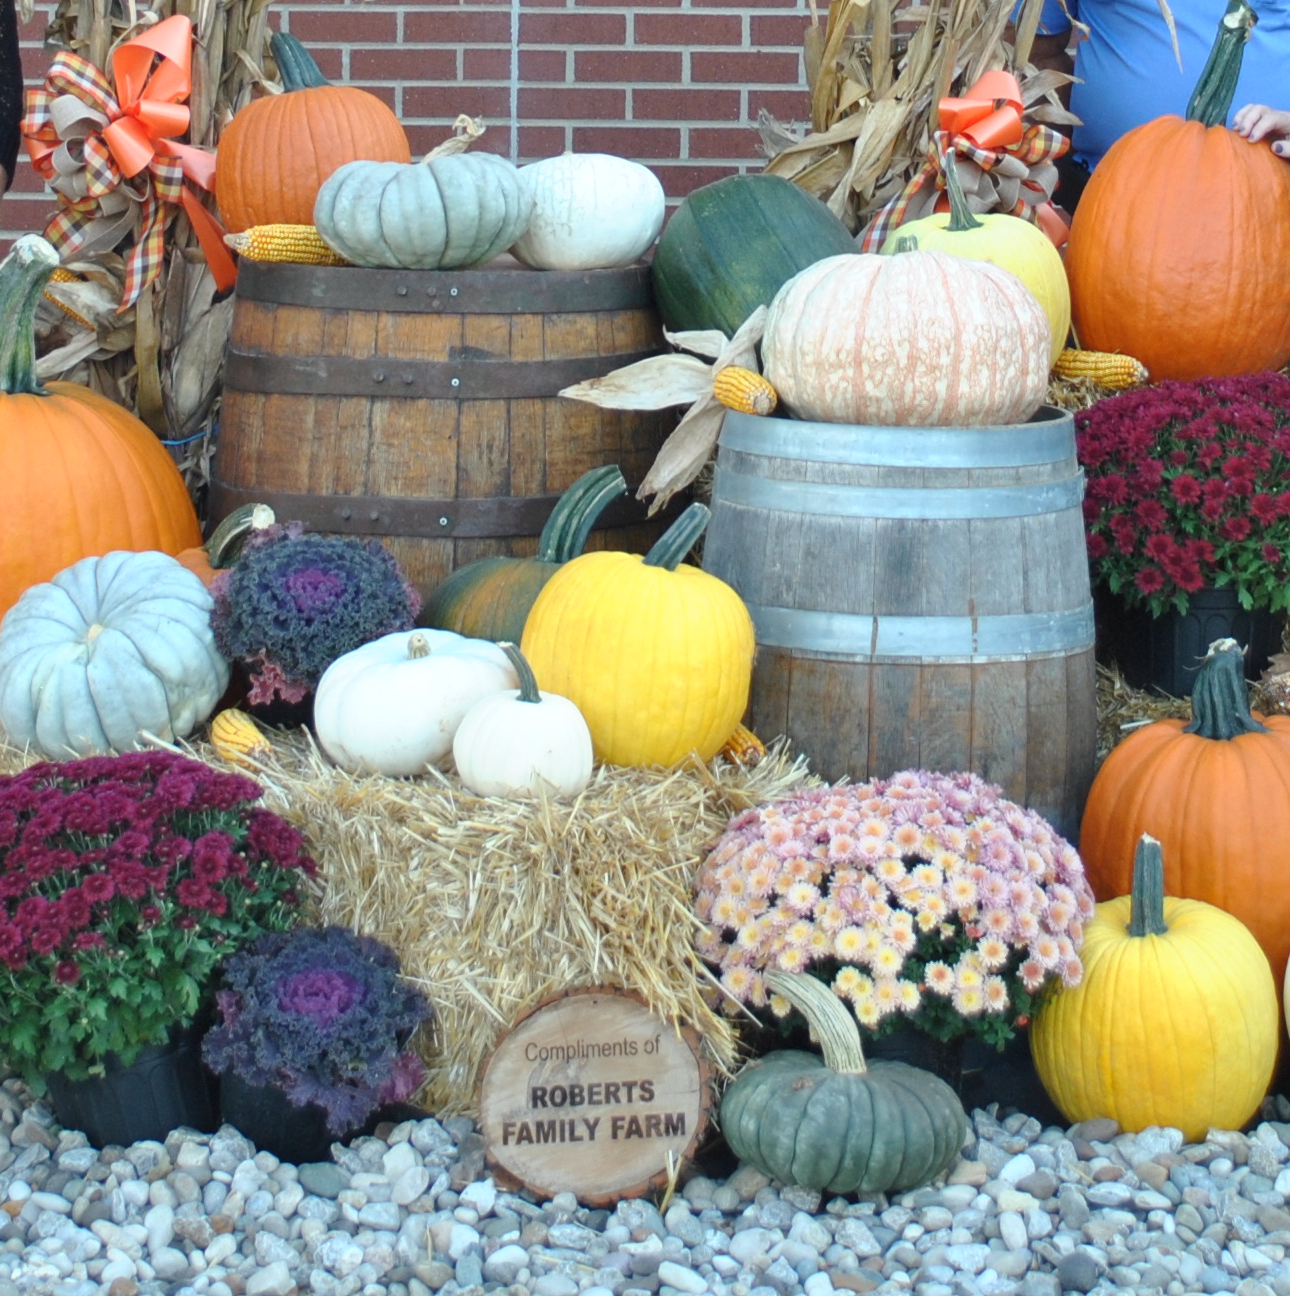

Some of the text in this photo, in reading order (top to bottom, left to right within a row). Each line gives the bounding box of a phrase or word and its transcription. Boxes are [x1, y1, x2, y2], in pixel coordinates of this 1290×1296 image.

[525, 1034, 661, 1065] Compliments of
[531, 1079, 655, 1109] ROBERTS
[502, 1112, 686, 1146] FAMILY FARM
